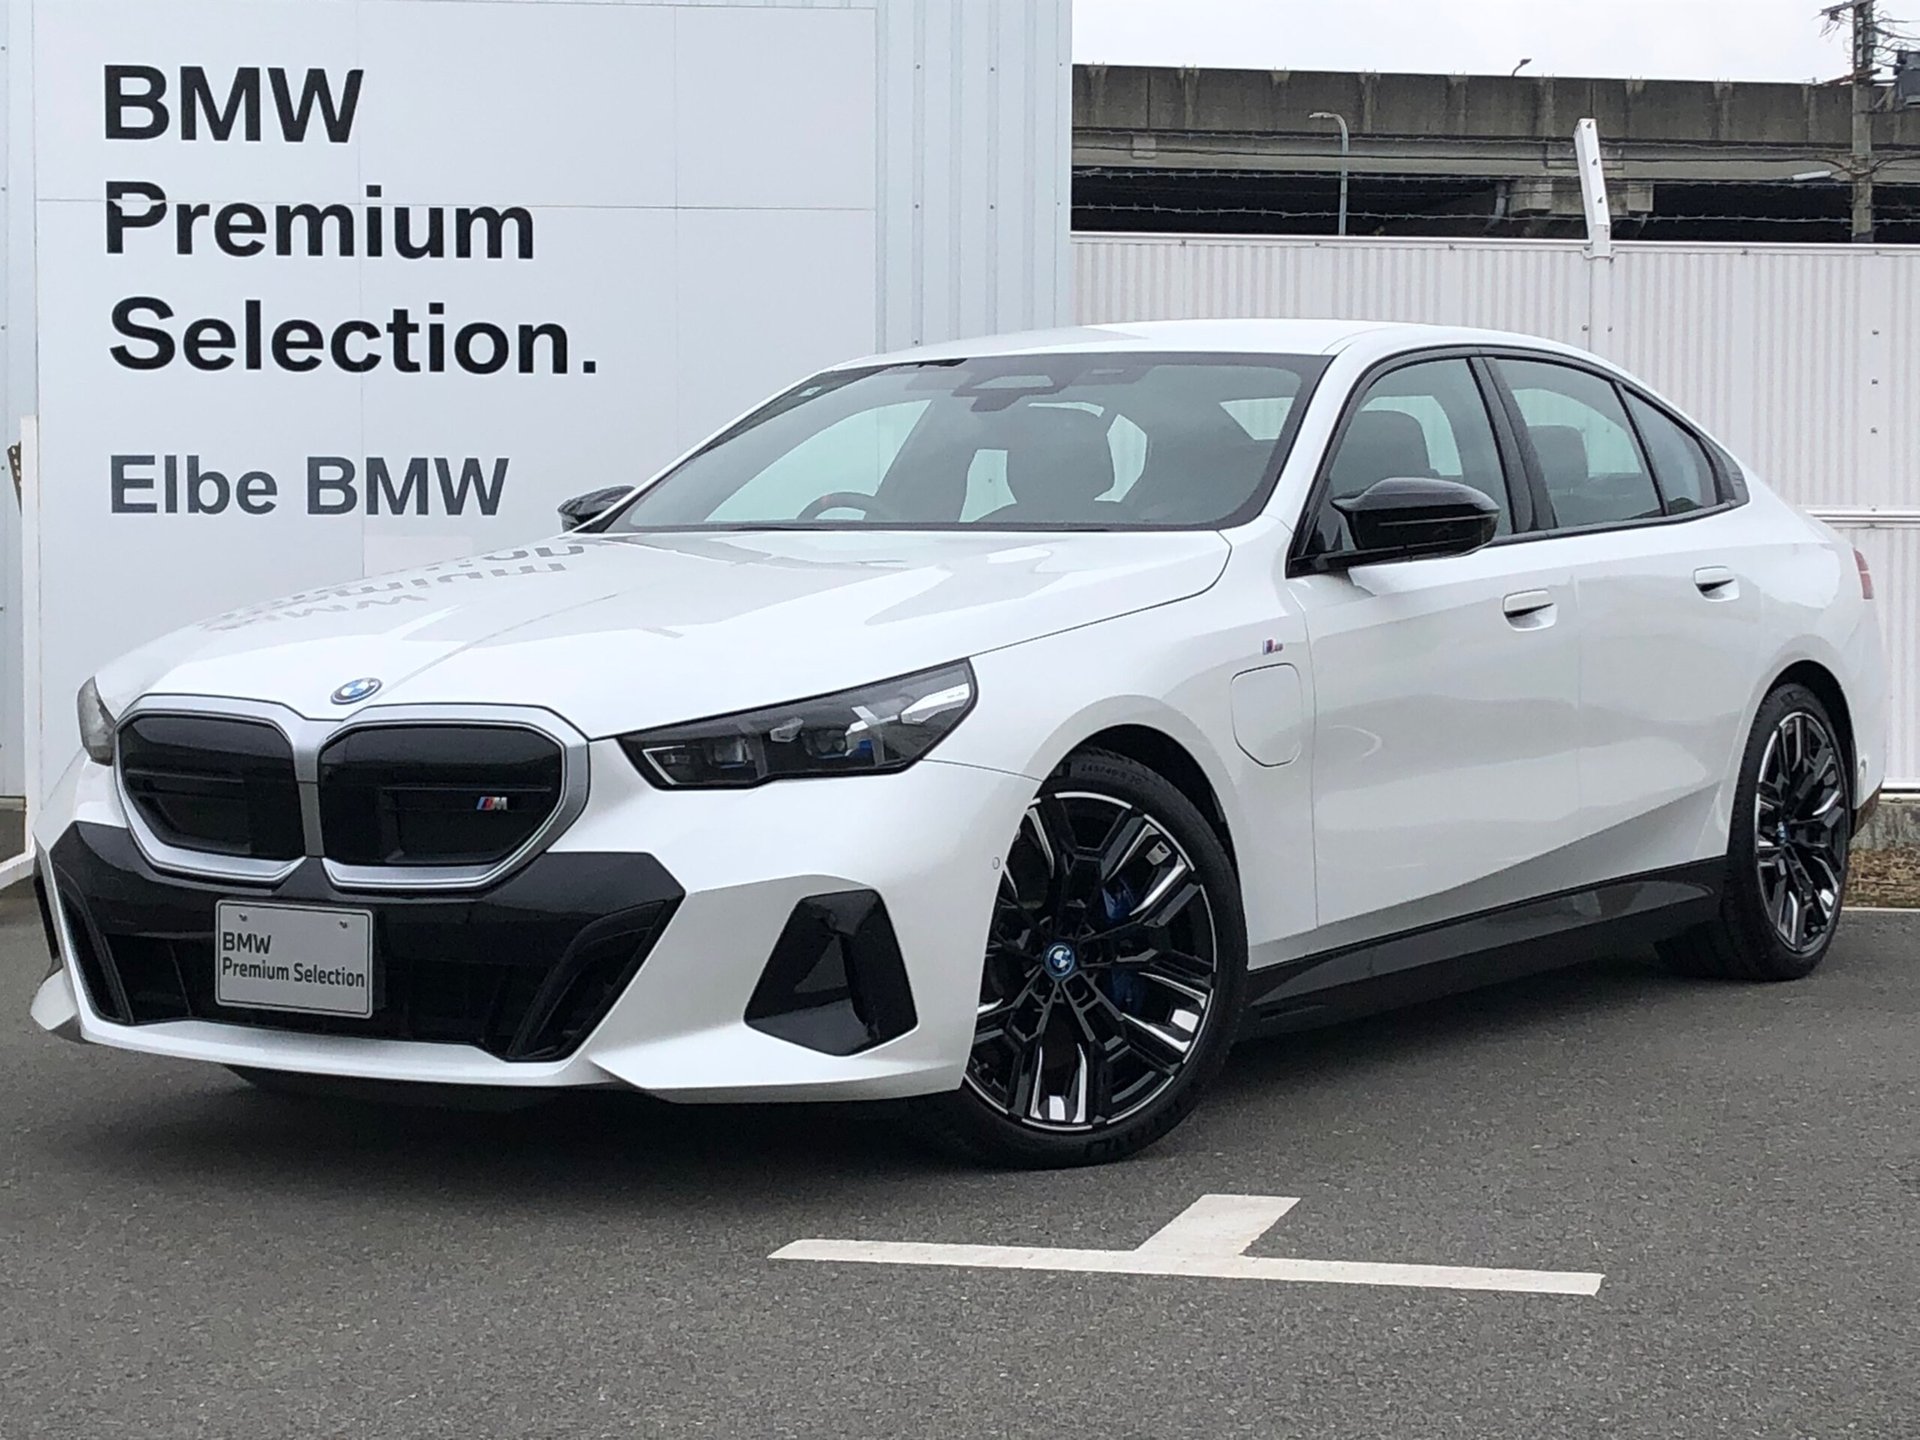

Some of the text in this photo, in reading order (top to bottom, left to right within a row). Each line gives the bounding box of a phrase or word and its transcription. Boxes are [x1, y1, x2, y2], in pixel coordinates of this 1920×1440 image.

[104, 64, 364, 143] BMW
[106, 181, 534, 260] Premium
[110, 296, 597, 375] Selection.
[110, 454, 510, 516] Elbe BMW
[222, 931, 272, 955] BMW
[222, 956, 365, 988] Premium Selection
